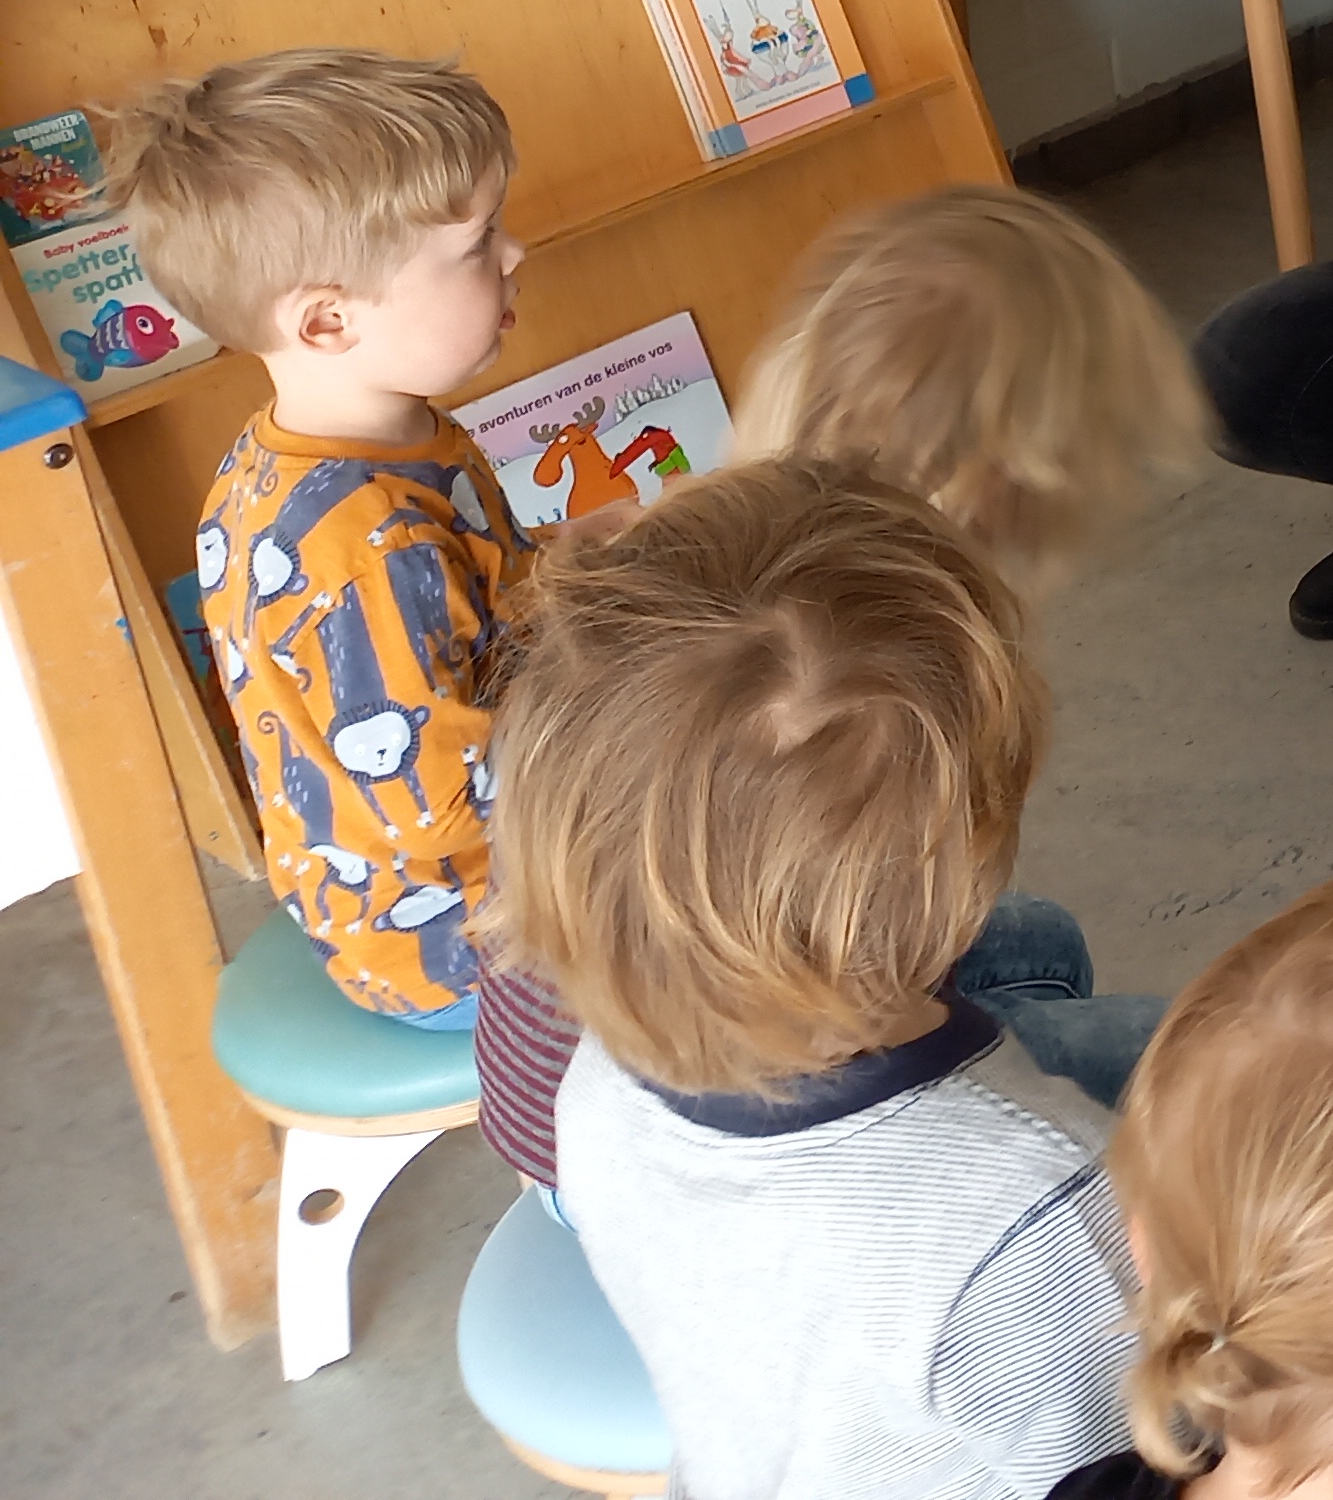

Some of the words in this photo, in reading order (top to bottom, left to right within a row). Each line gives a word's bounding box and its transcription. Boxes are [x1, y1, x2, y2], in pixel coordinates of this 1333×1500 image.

[43, 242, 75, 260] Baby
[479, 394, 553, 434] avonturen
[555, 382, 581, 400] van
[584, 371, 603, 388] de
[604, 353, 647, 379] kleine
[648, 341, 673, 358] vos
